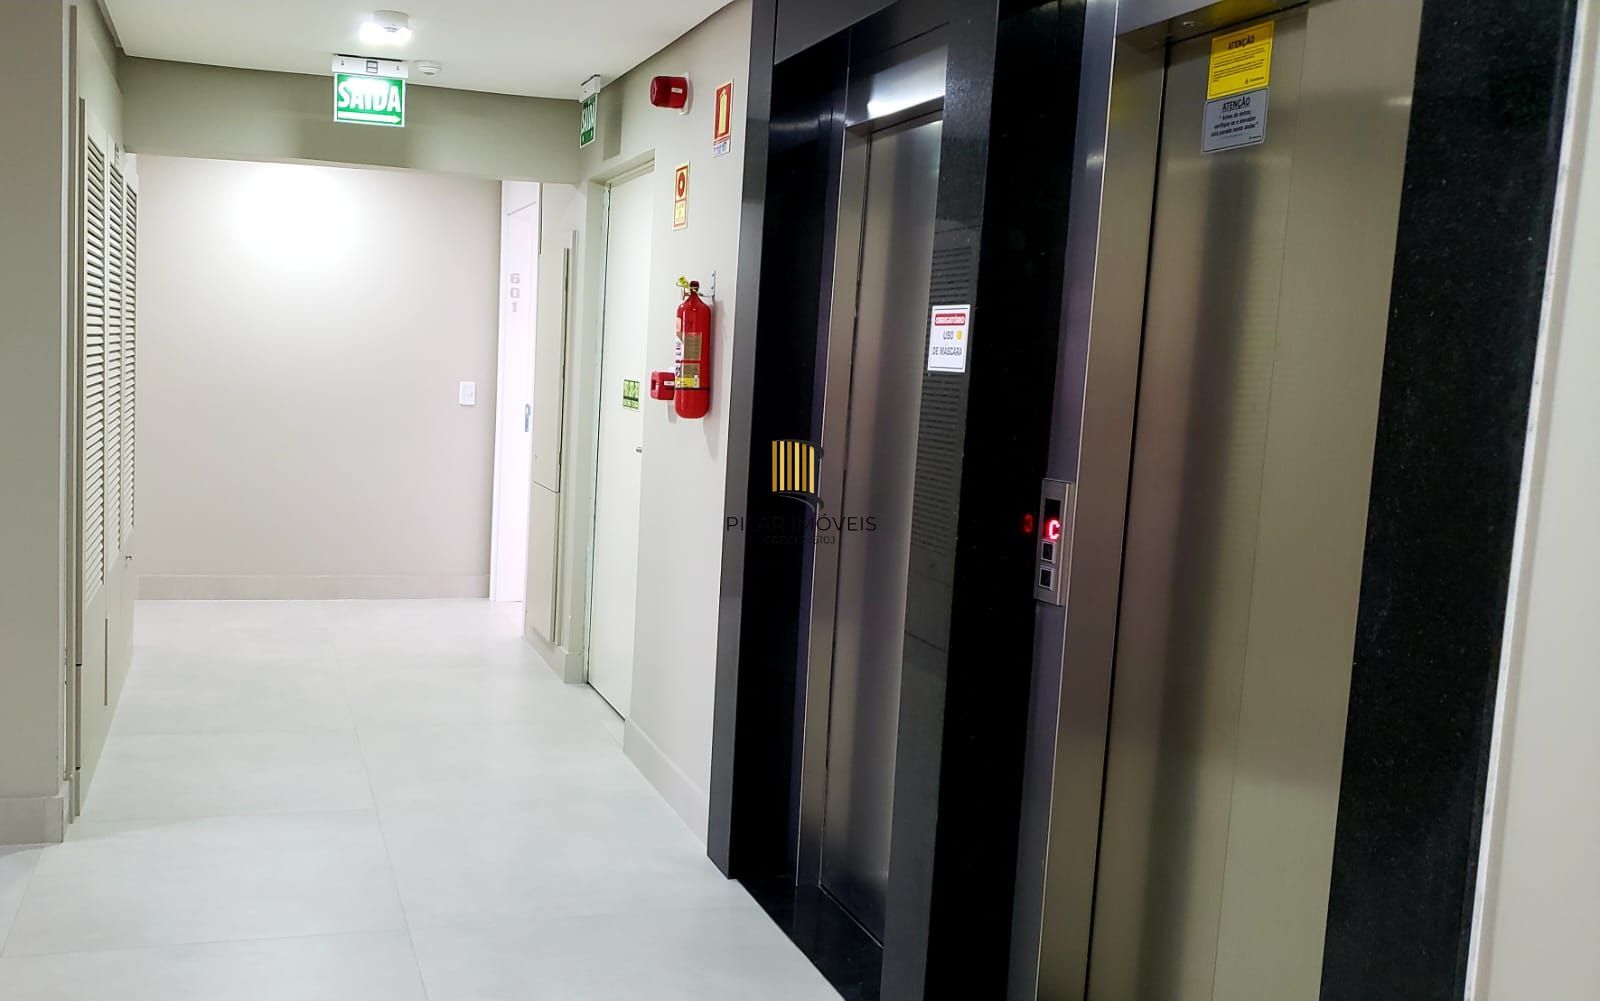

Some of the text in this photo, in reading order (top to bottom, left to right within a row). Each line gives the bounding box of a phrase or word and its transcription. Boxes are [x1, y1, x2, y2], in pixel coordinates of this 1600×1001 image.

[1222, 96, 1251, 111] ATENÇÃO
[510, 272, 521, 313] 601
[943, 330, 954, 341] USO
